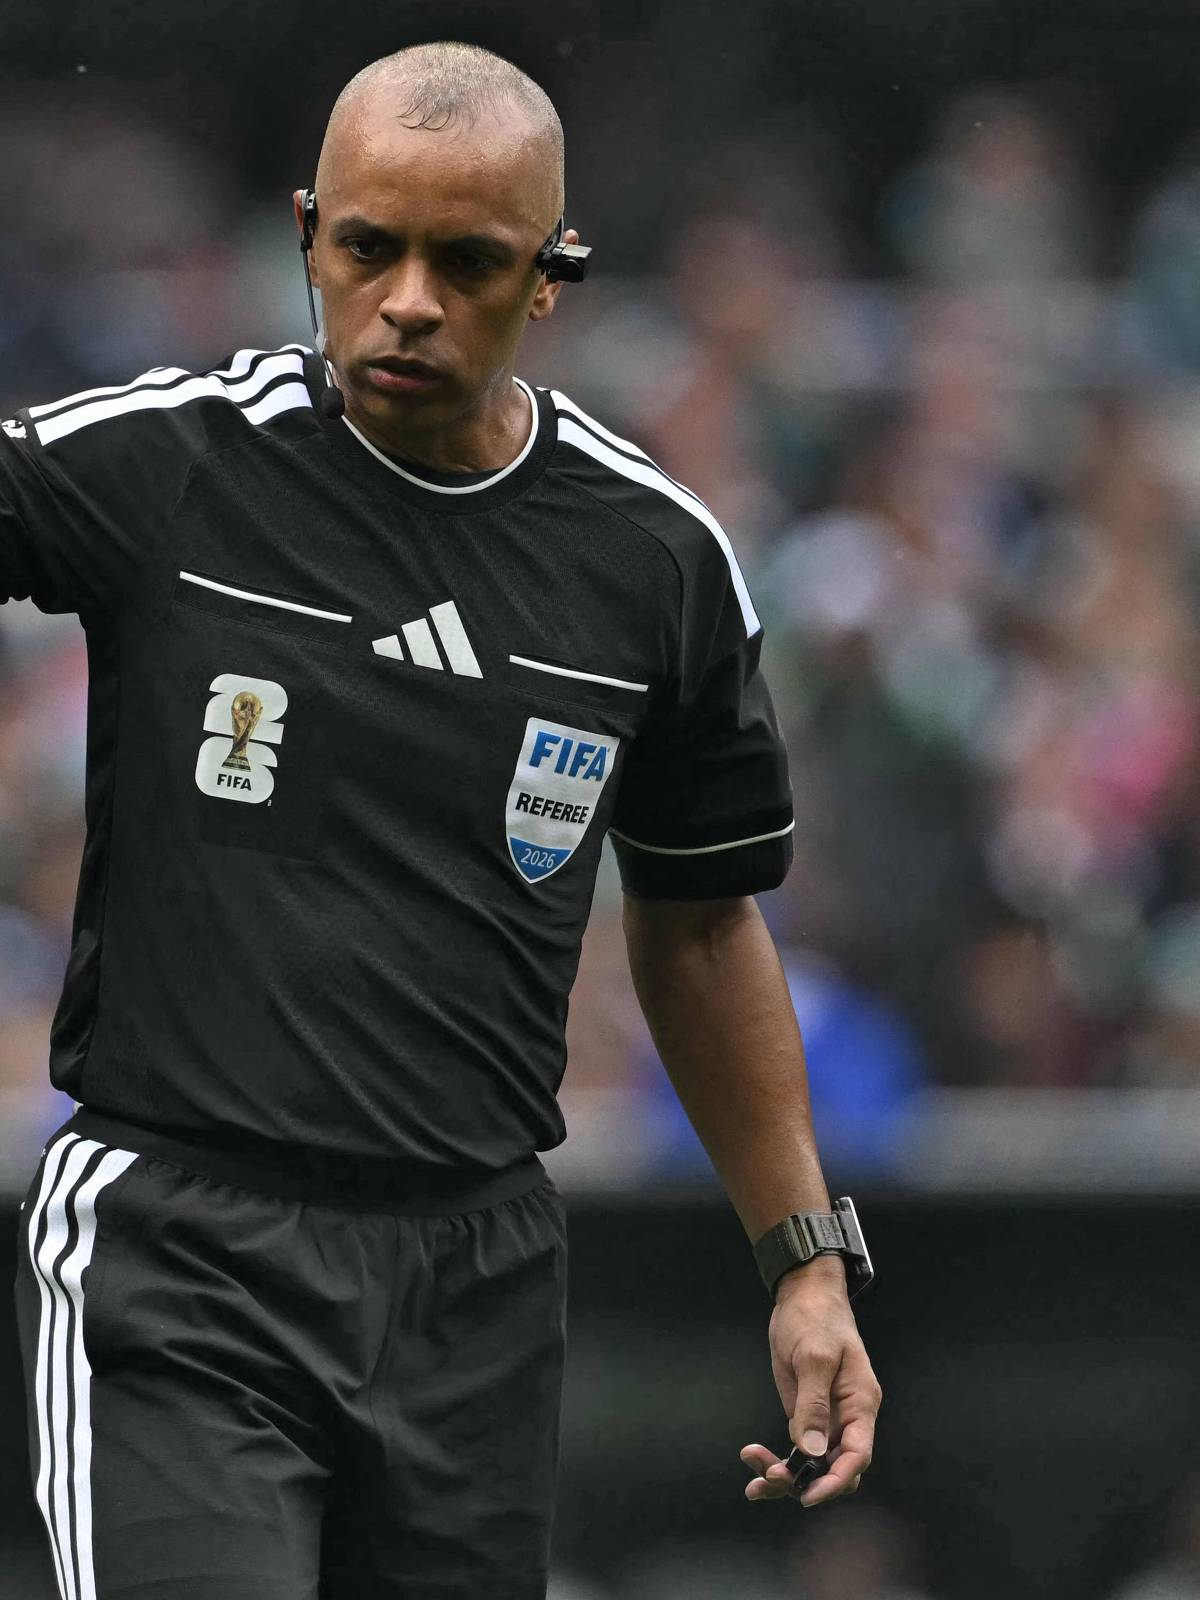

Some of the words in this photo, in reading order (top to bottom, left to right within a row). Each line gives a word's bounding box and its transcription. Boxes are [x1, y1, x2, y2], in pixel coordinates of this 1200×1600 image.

[529, 730, 608, 782] FIFA
[216, 773, 252, 791] FIFA
[515, 792, 590, 824] REFEREE
[520, 848, 557, 869] 2026
